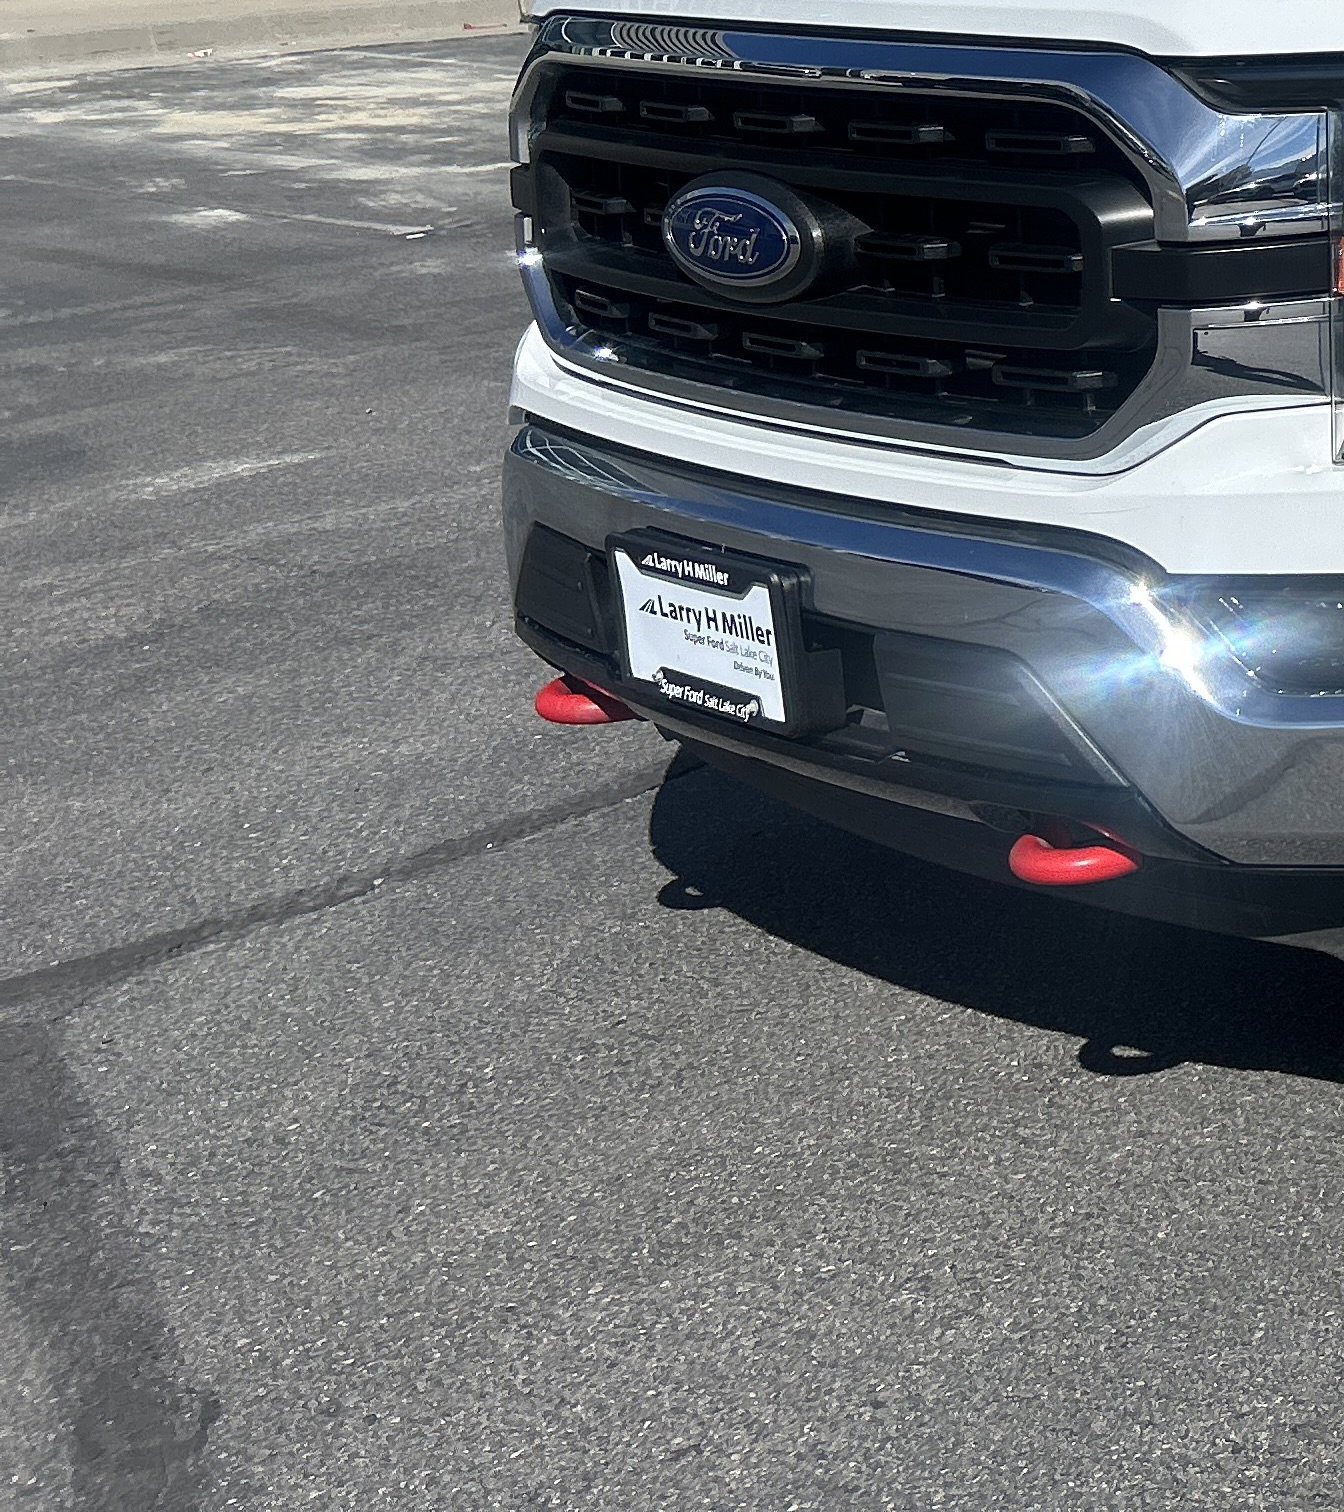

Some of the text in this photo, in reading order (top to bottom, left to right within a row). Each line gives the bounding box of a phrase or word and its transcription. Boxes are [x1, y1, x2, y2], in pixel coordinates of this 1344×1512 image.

[689, 207, 760, 265] Ford
[653, 552, 729, 586] Larry H Miller
[658, 595, 772, 646] Larry H Miller
[684, 629, 705, 645] Super
[707, 636, 725, 651] Ford
[660, 679, 751, 722] Super Ford Salt Lake City
